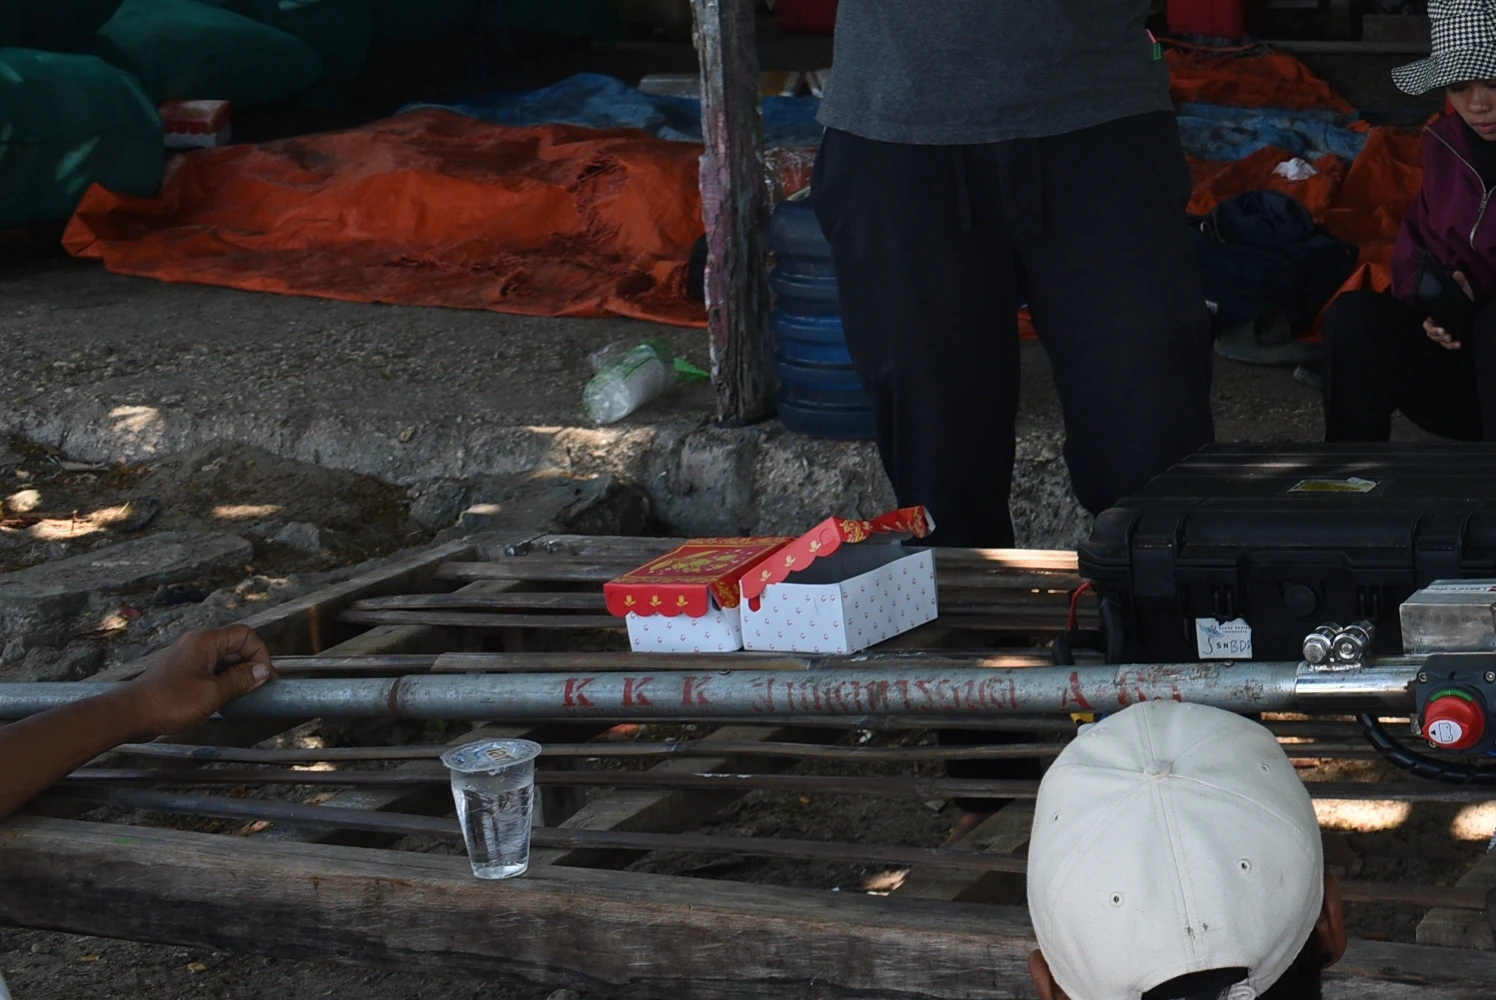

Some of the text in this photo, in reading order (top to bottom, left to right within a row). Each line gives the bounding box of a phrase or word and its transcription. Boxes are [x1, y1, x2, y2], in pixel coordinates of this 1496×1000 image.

[563, 675, 714, 707] K K K
